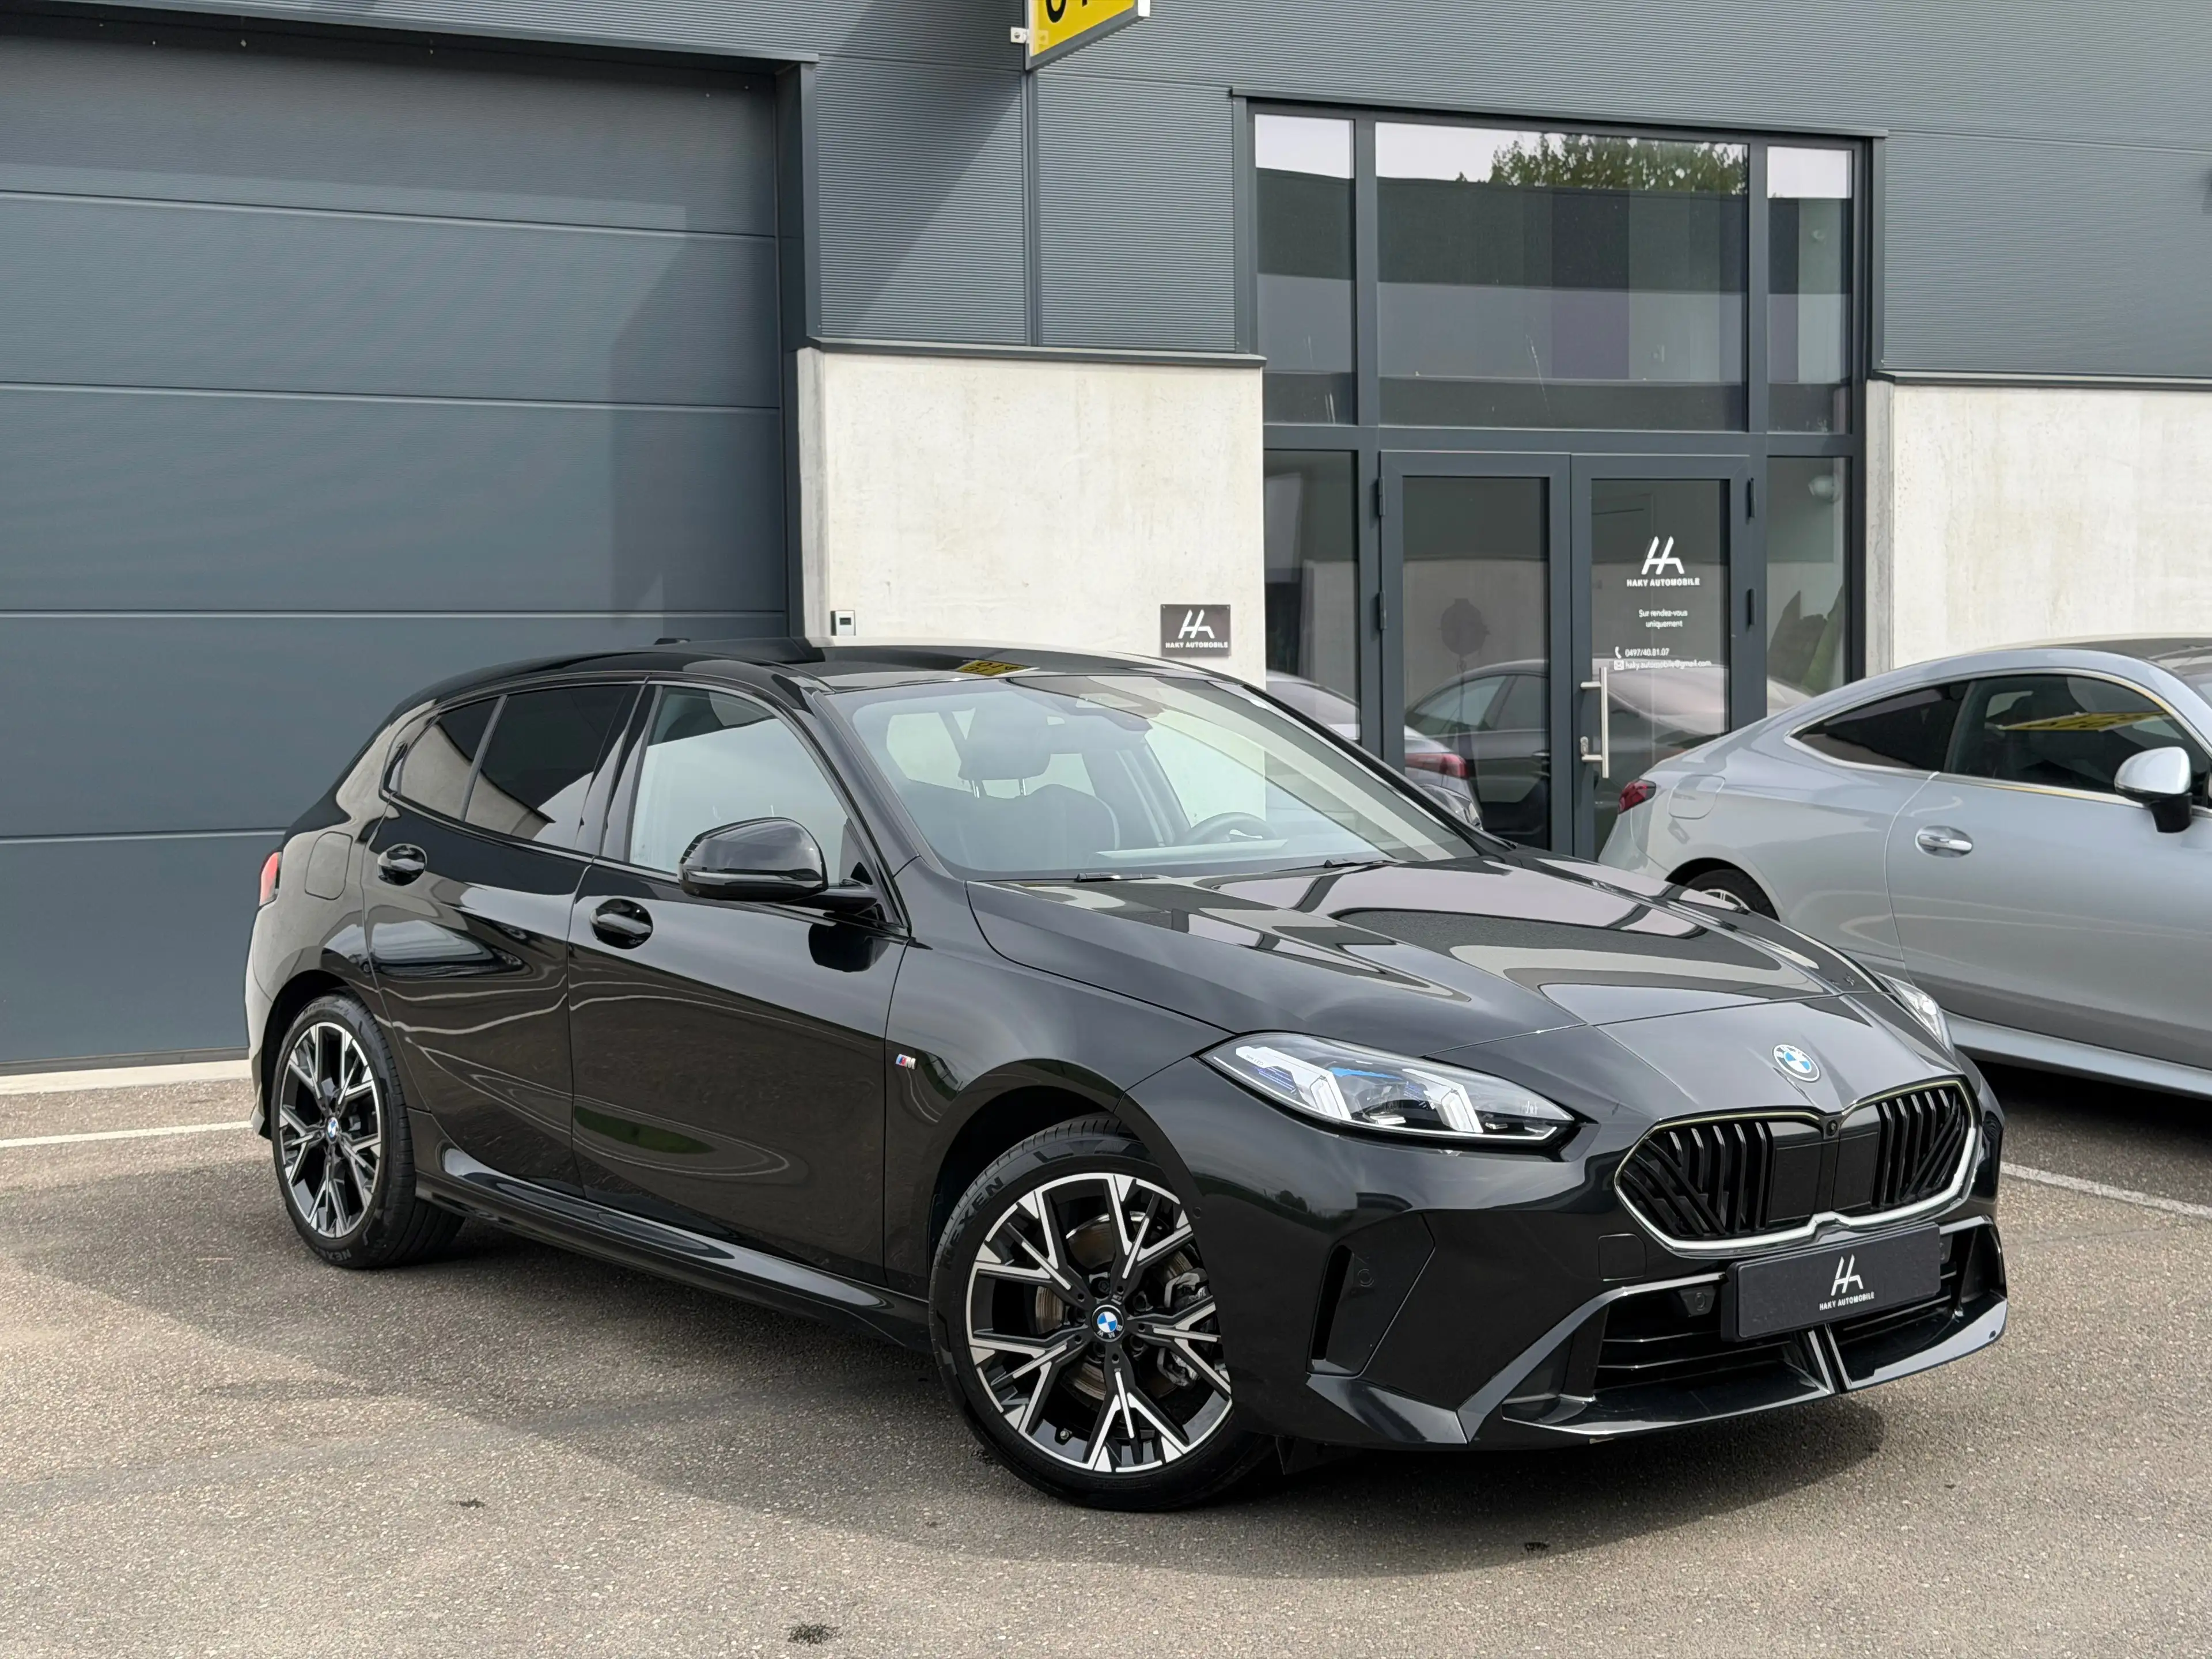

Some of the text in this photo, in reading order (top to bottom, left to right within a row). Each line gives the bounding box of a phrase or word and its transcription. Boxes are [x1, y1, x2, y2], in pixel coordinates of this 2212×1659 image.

[1650, 577, 1700, 586] AUTOMOBILE
[1638, 608, 1688, 618] Sur rendez-vous
[1645, 620, 1683, 629] uniquement
[941, 1176, 1003, 1270] NEXEN
[1819, 1291, 1875, 1311] HAKY AUTOMOBILE
